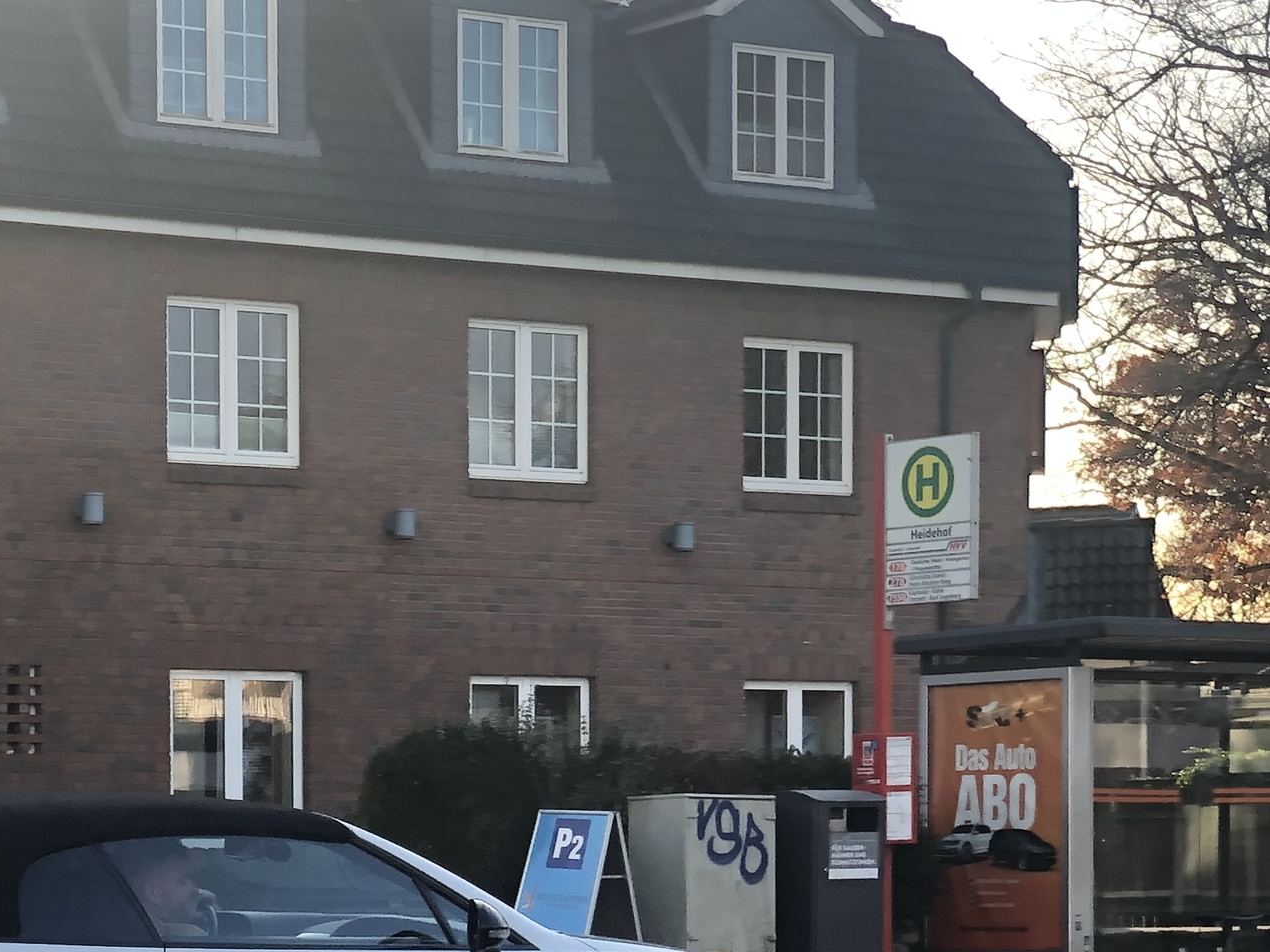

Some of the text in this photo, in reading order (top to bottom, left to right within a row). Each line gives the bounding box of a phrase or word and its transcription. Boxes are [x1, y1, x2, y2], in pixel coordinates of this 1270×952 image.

[916, 462, 939, 501] H
[911, 526, 952, 539] Heidehof
[955, 743, 1036, 771] Das Auto
[955, 773, 1036, 830] ABO
[553, 827, 584, 860] P2
